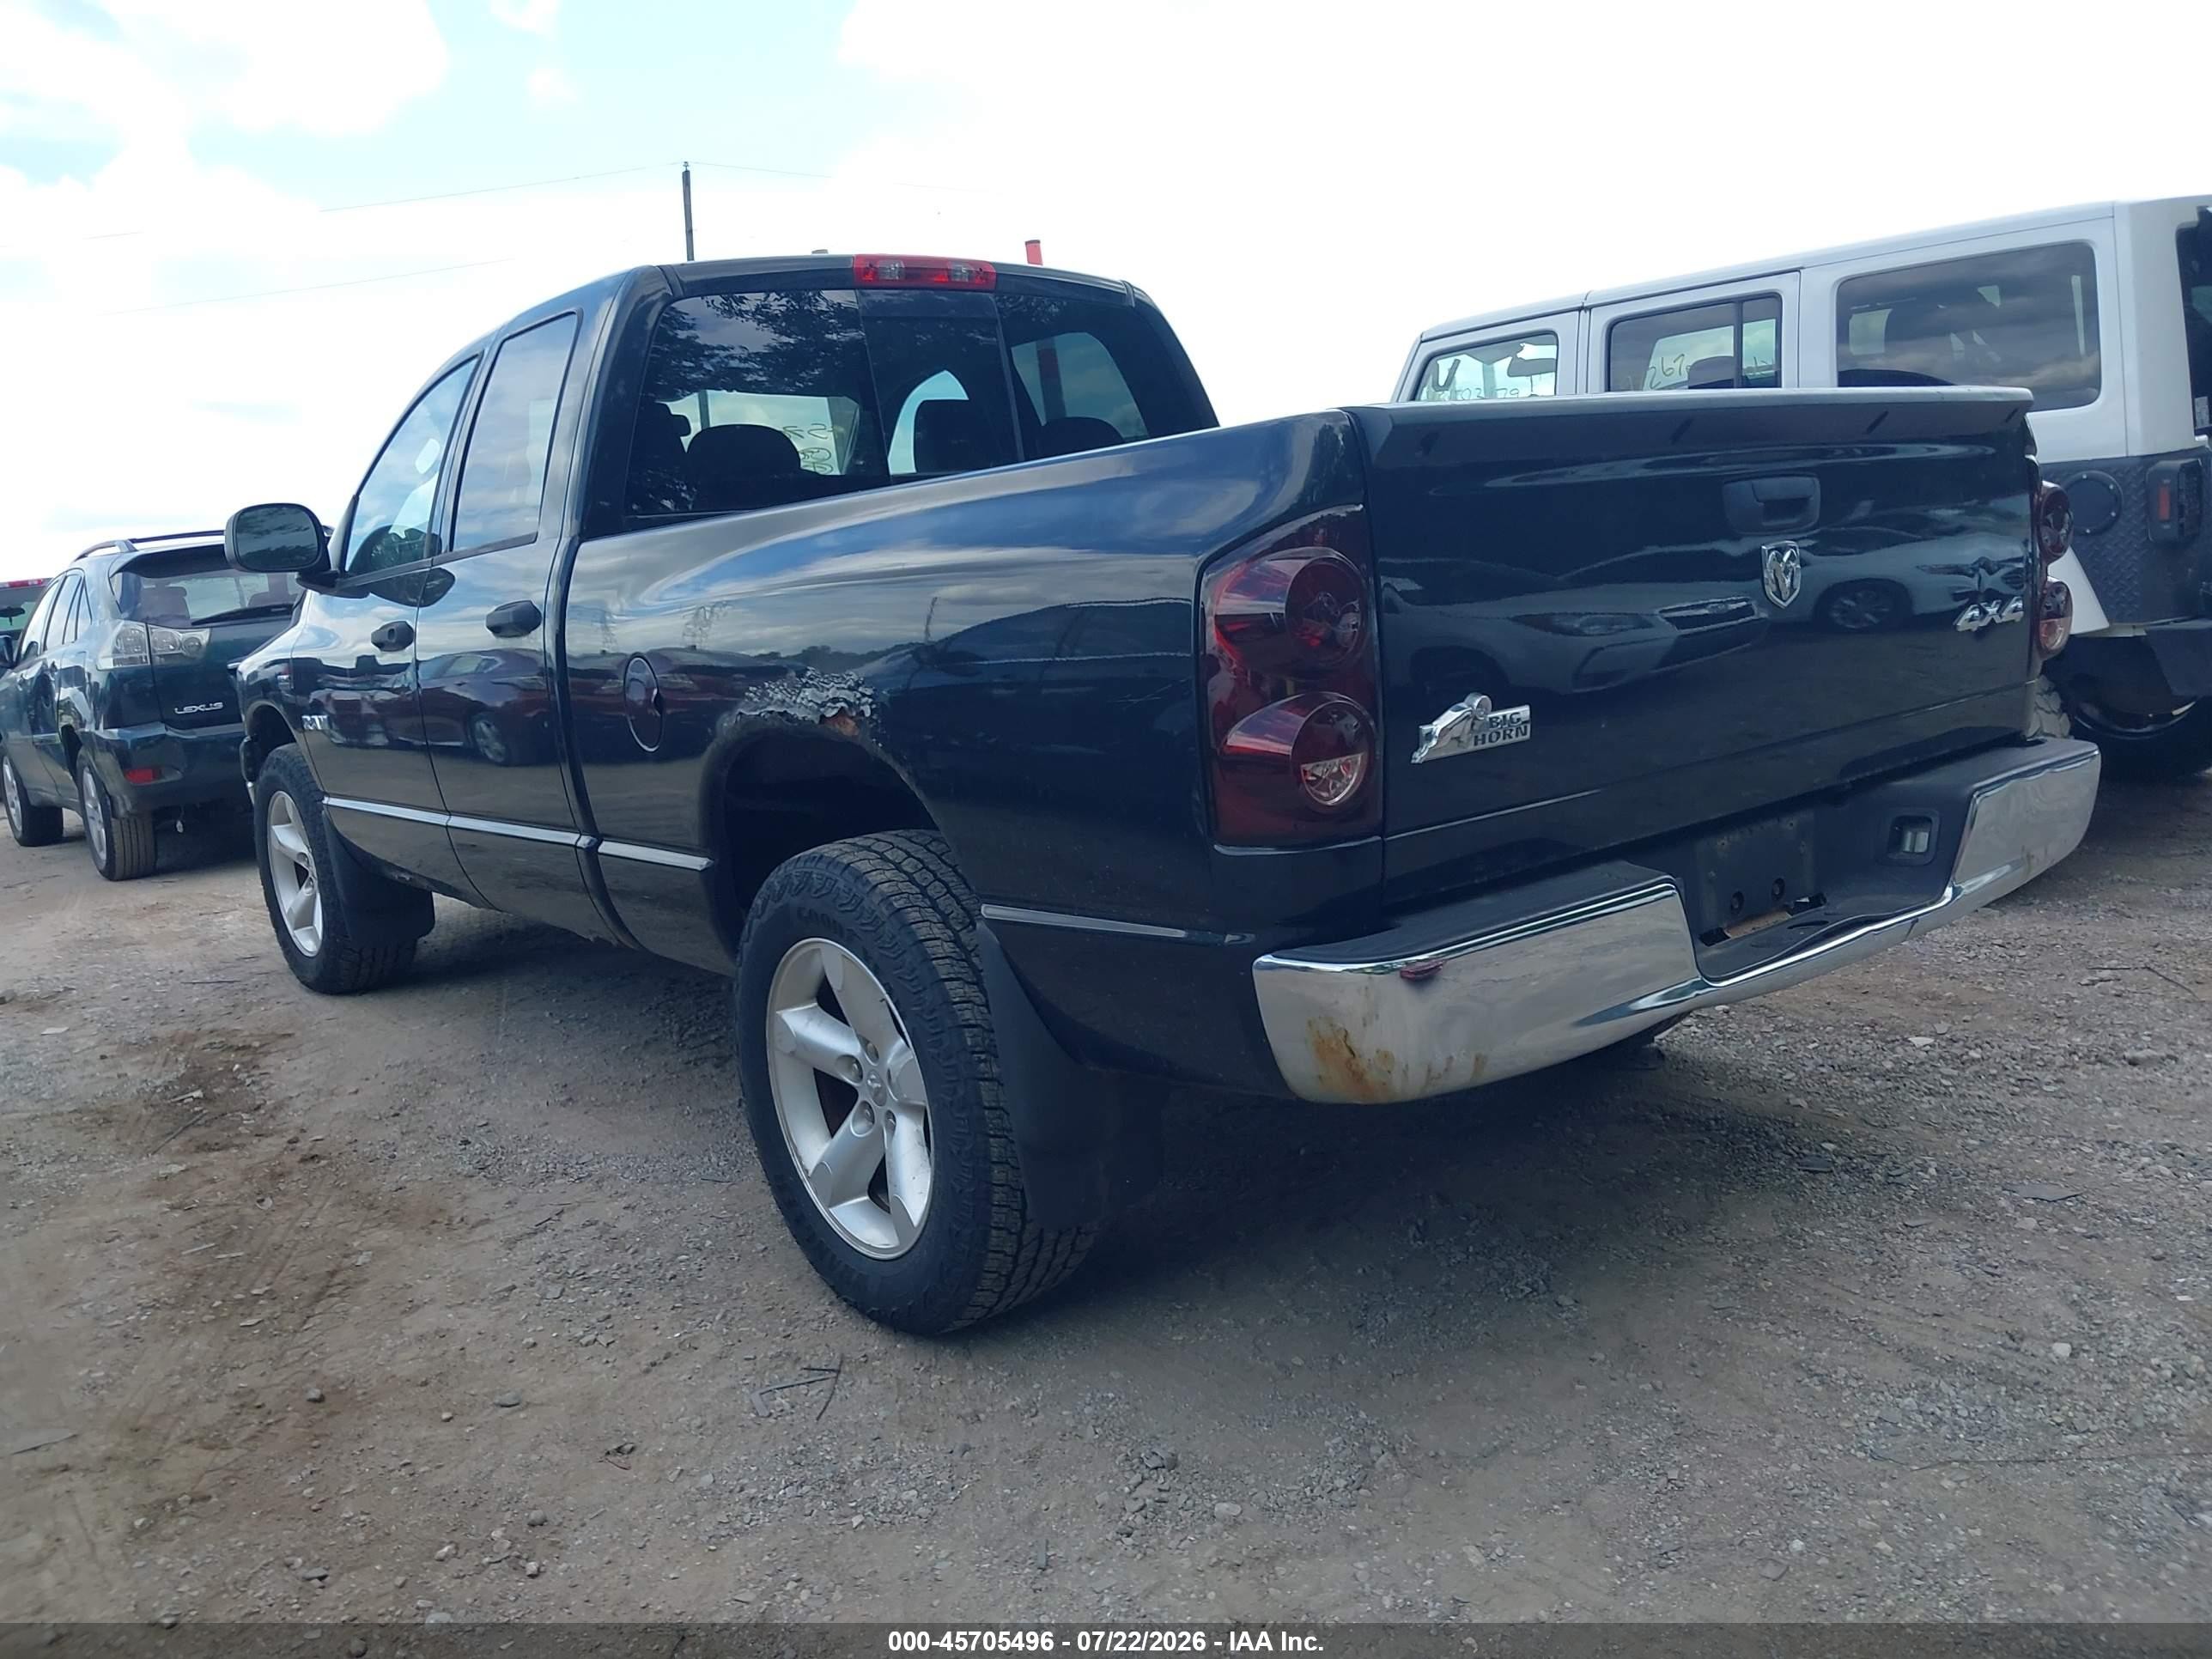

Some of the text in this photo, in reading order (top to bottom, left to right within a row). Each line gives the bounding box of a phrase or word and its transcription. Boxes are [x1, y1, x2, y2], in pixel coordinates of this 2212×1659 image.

[174, 702, 223, 714] LEXUS
[1488, 711, 1522, 729] BIG
[1474, 725, 1528, 746] HORN
